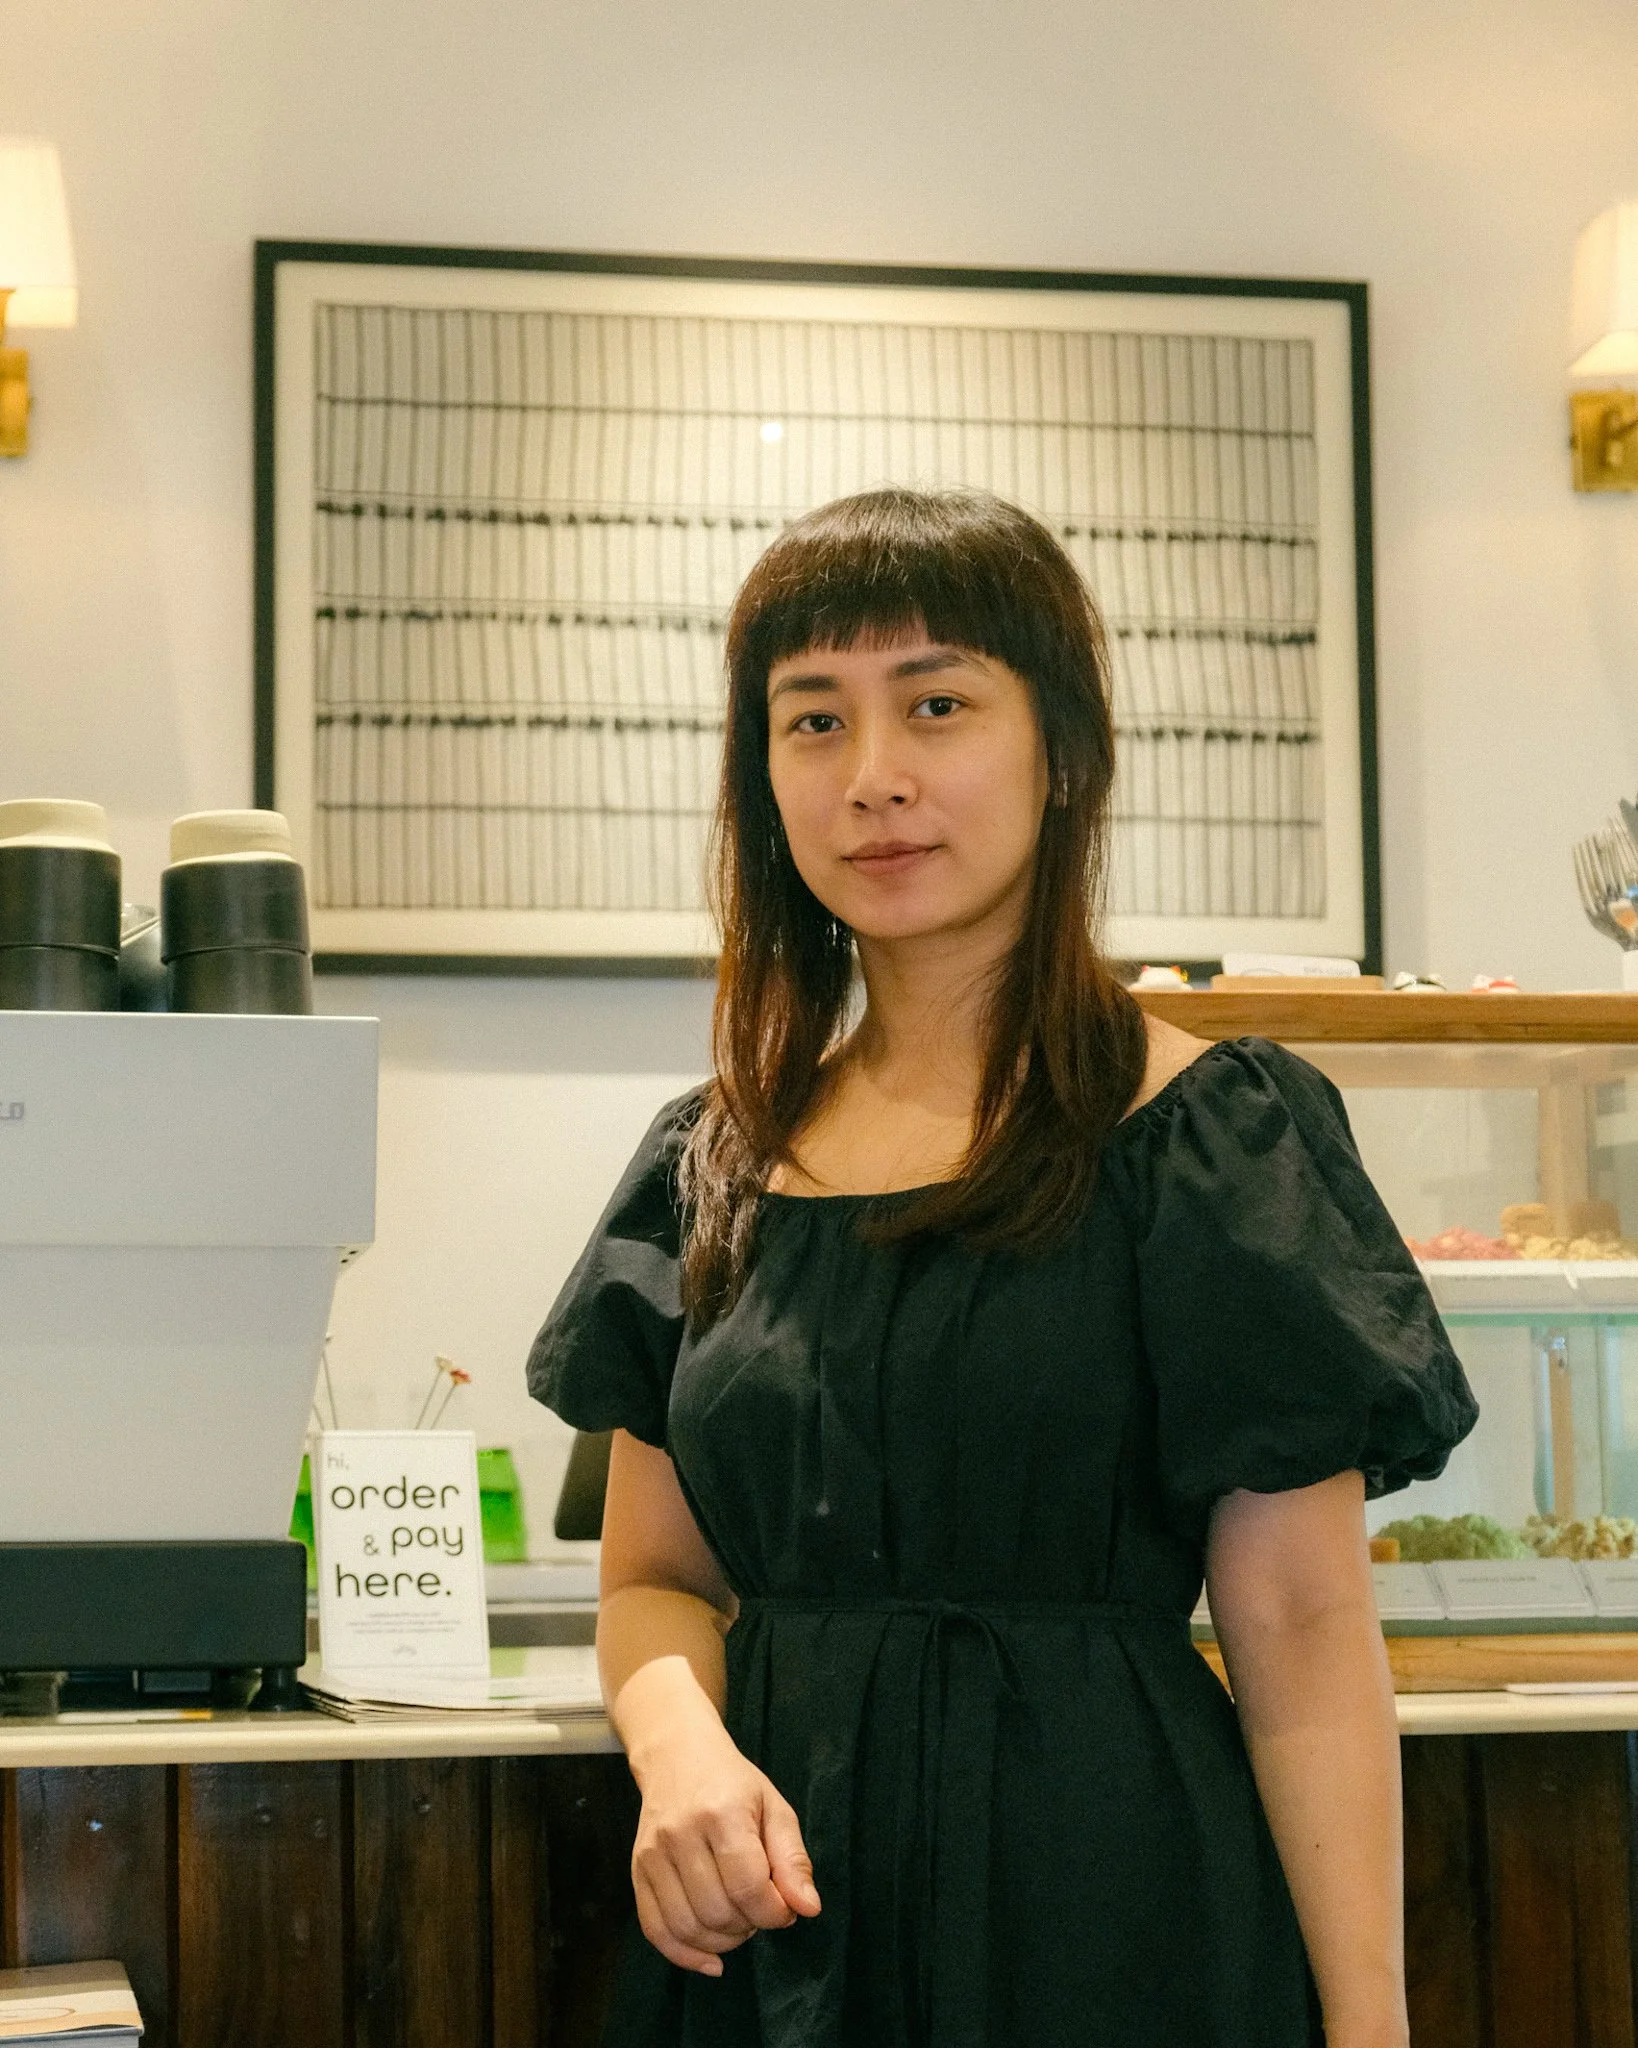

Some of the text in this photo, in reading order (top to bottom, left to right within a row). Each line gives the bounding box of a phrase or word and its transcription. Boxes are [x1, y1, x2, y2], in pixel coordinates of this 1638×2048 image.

[331, 1475, 460, 1510] order
[364, 1526, 464, 1557] & pay
[336, 1563, 451, 1598] here.
